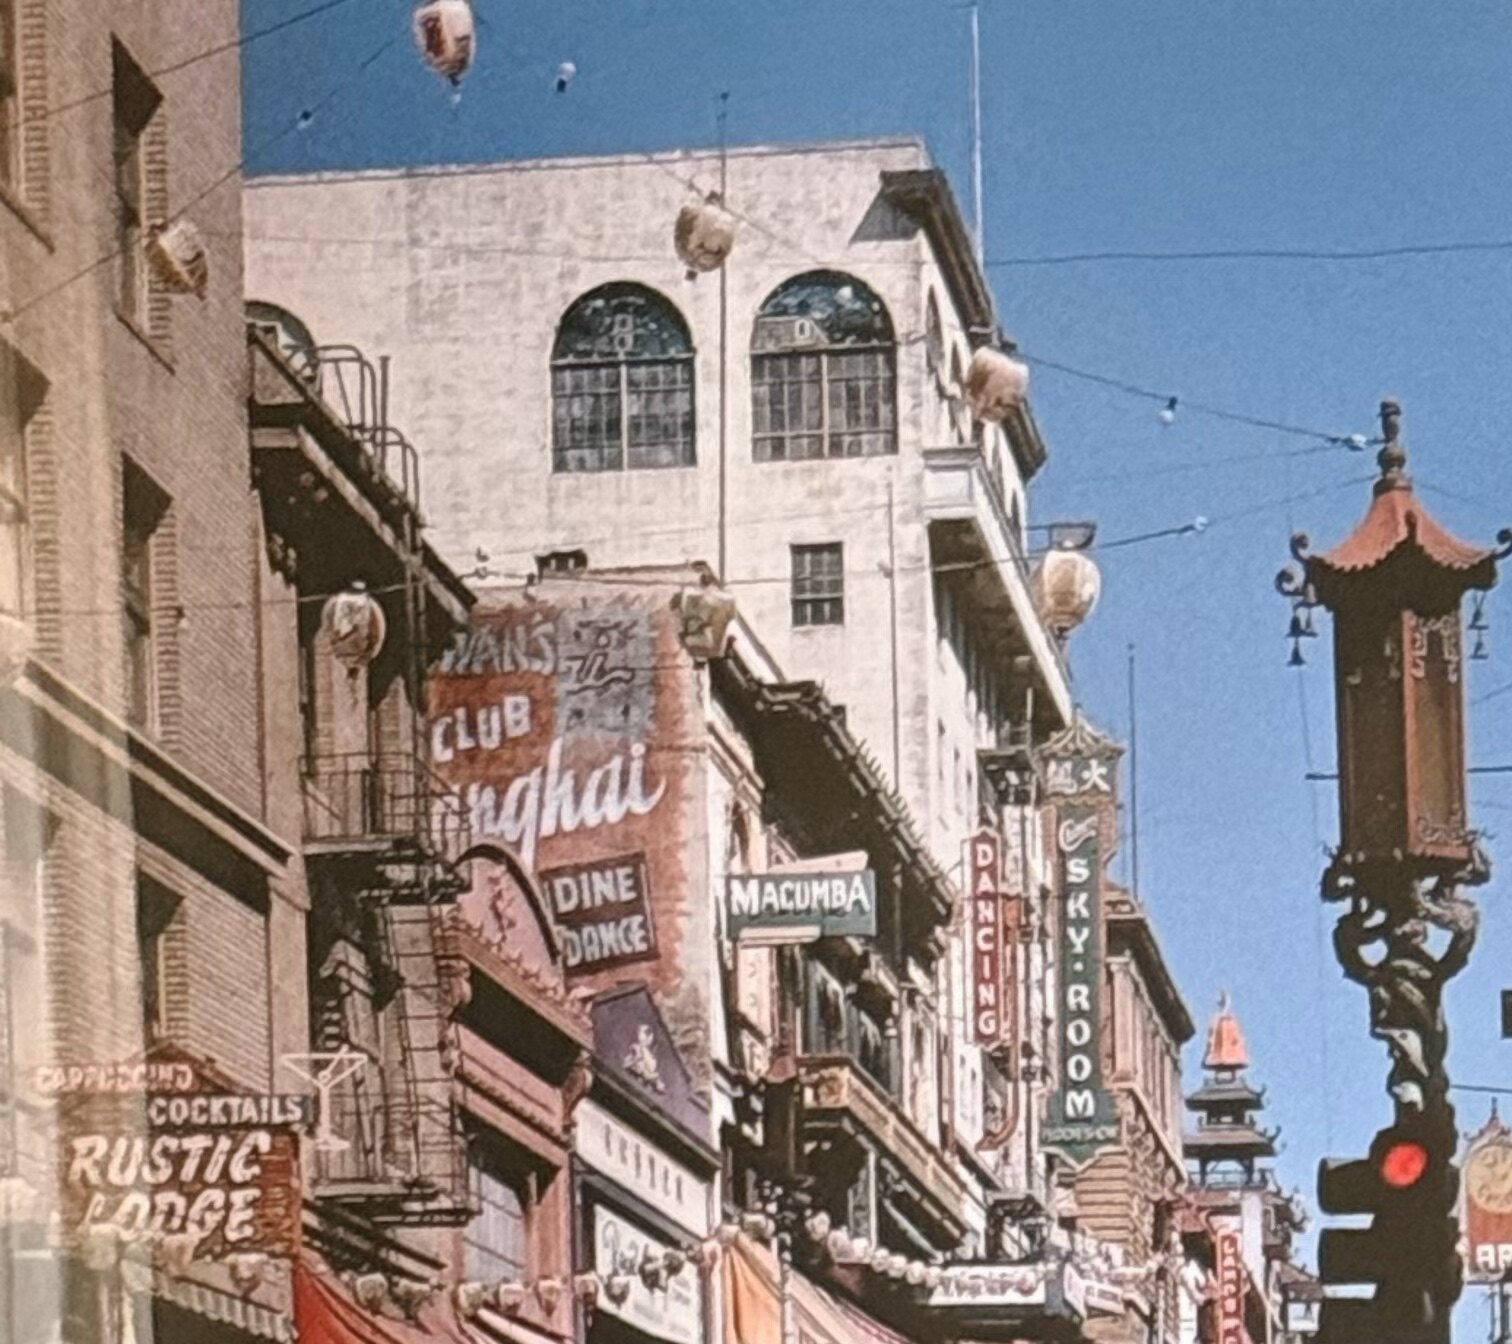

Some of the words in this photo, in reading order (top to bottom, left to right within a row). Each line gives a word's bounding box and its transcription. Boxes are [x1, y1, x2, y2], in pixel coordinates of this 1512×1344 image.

[431, 695, 531, 762] CLUB
[556, 866, 638, 914] DINE
[730, 874, 871, 916] MACUMBA
[562, 914, 648, 967] DANCE
[976, 843, 998, 1035] DANCING
[1066, 984, 1096, 1118] ROOM
[150, 1097, 302, 1125] COCKTAILS
[67, 1131, 271, 1187] RUSTIC
[80, 1188, 262, 1243] LODGE
